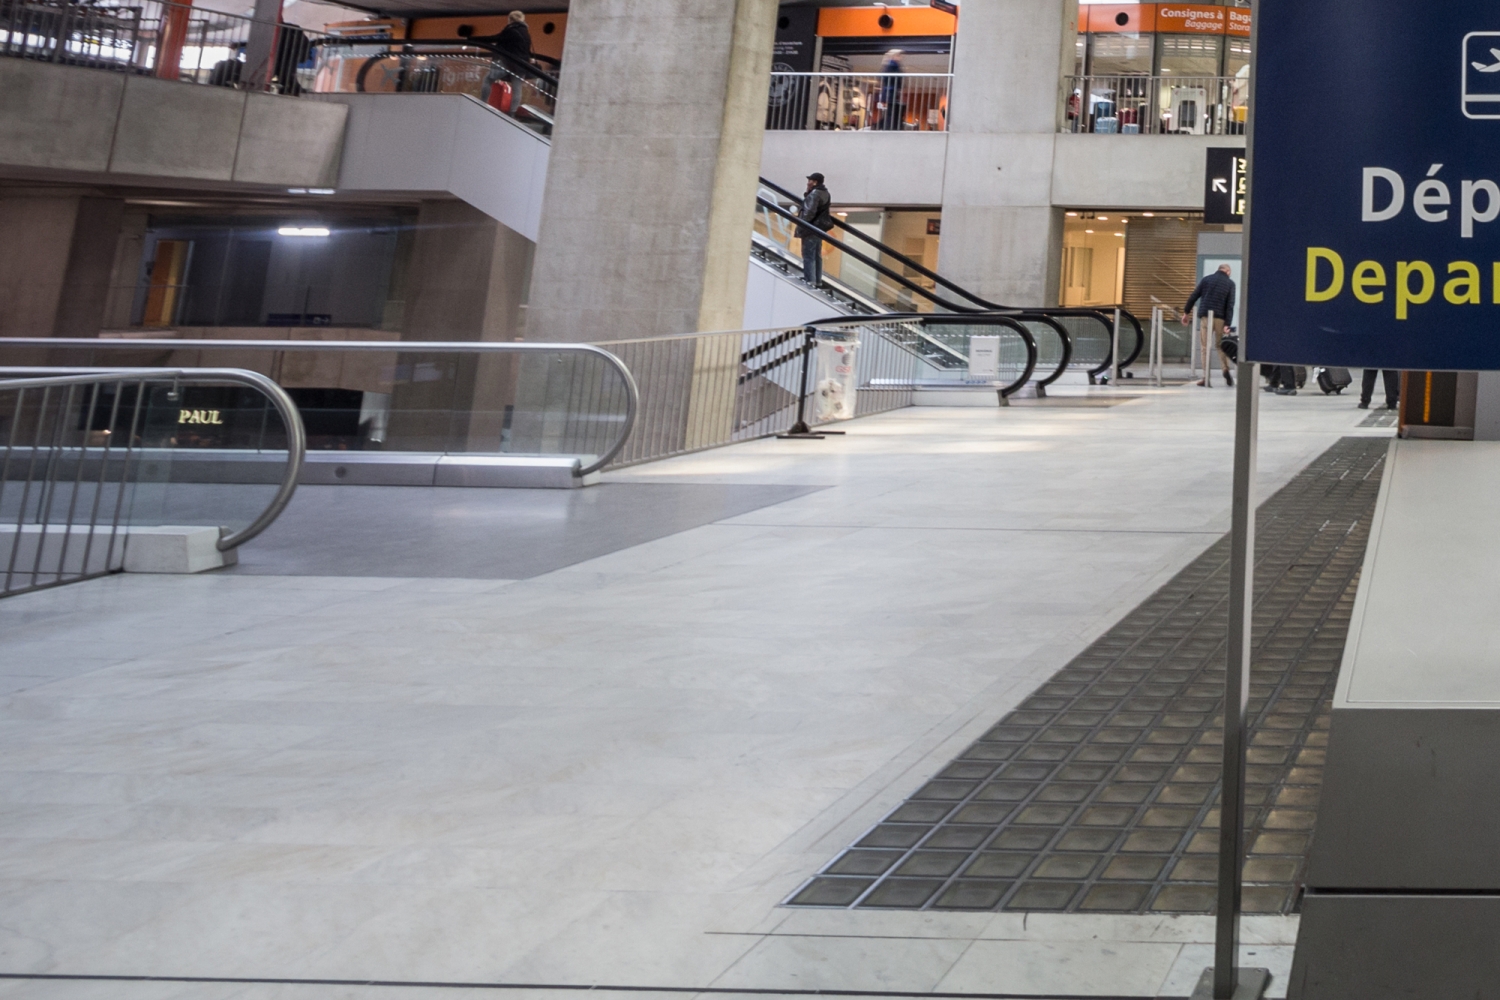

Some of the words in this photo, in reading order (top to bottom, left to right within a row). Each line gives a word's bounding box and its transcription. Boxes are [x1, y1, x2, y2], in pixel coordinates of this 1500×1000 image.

[1160, 8, 1215, 20] Consignes
[1216, 10, 1223, 20] à
[1184, 20, 1222, 30] Baggage
[178, 409, 223, 424] PAUL
